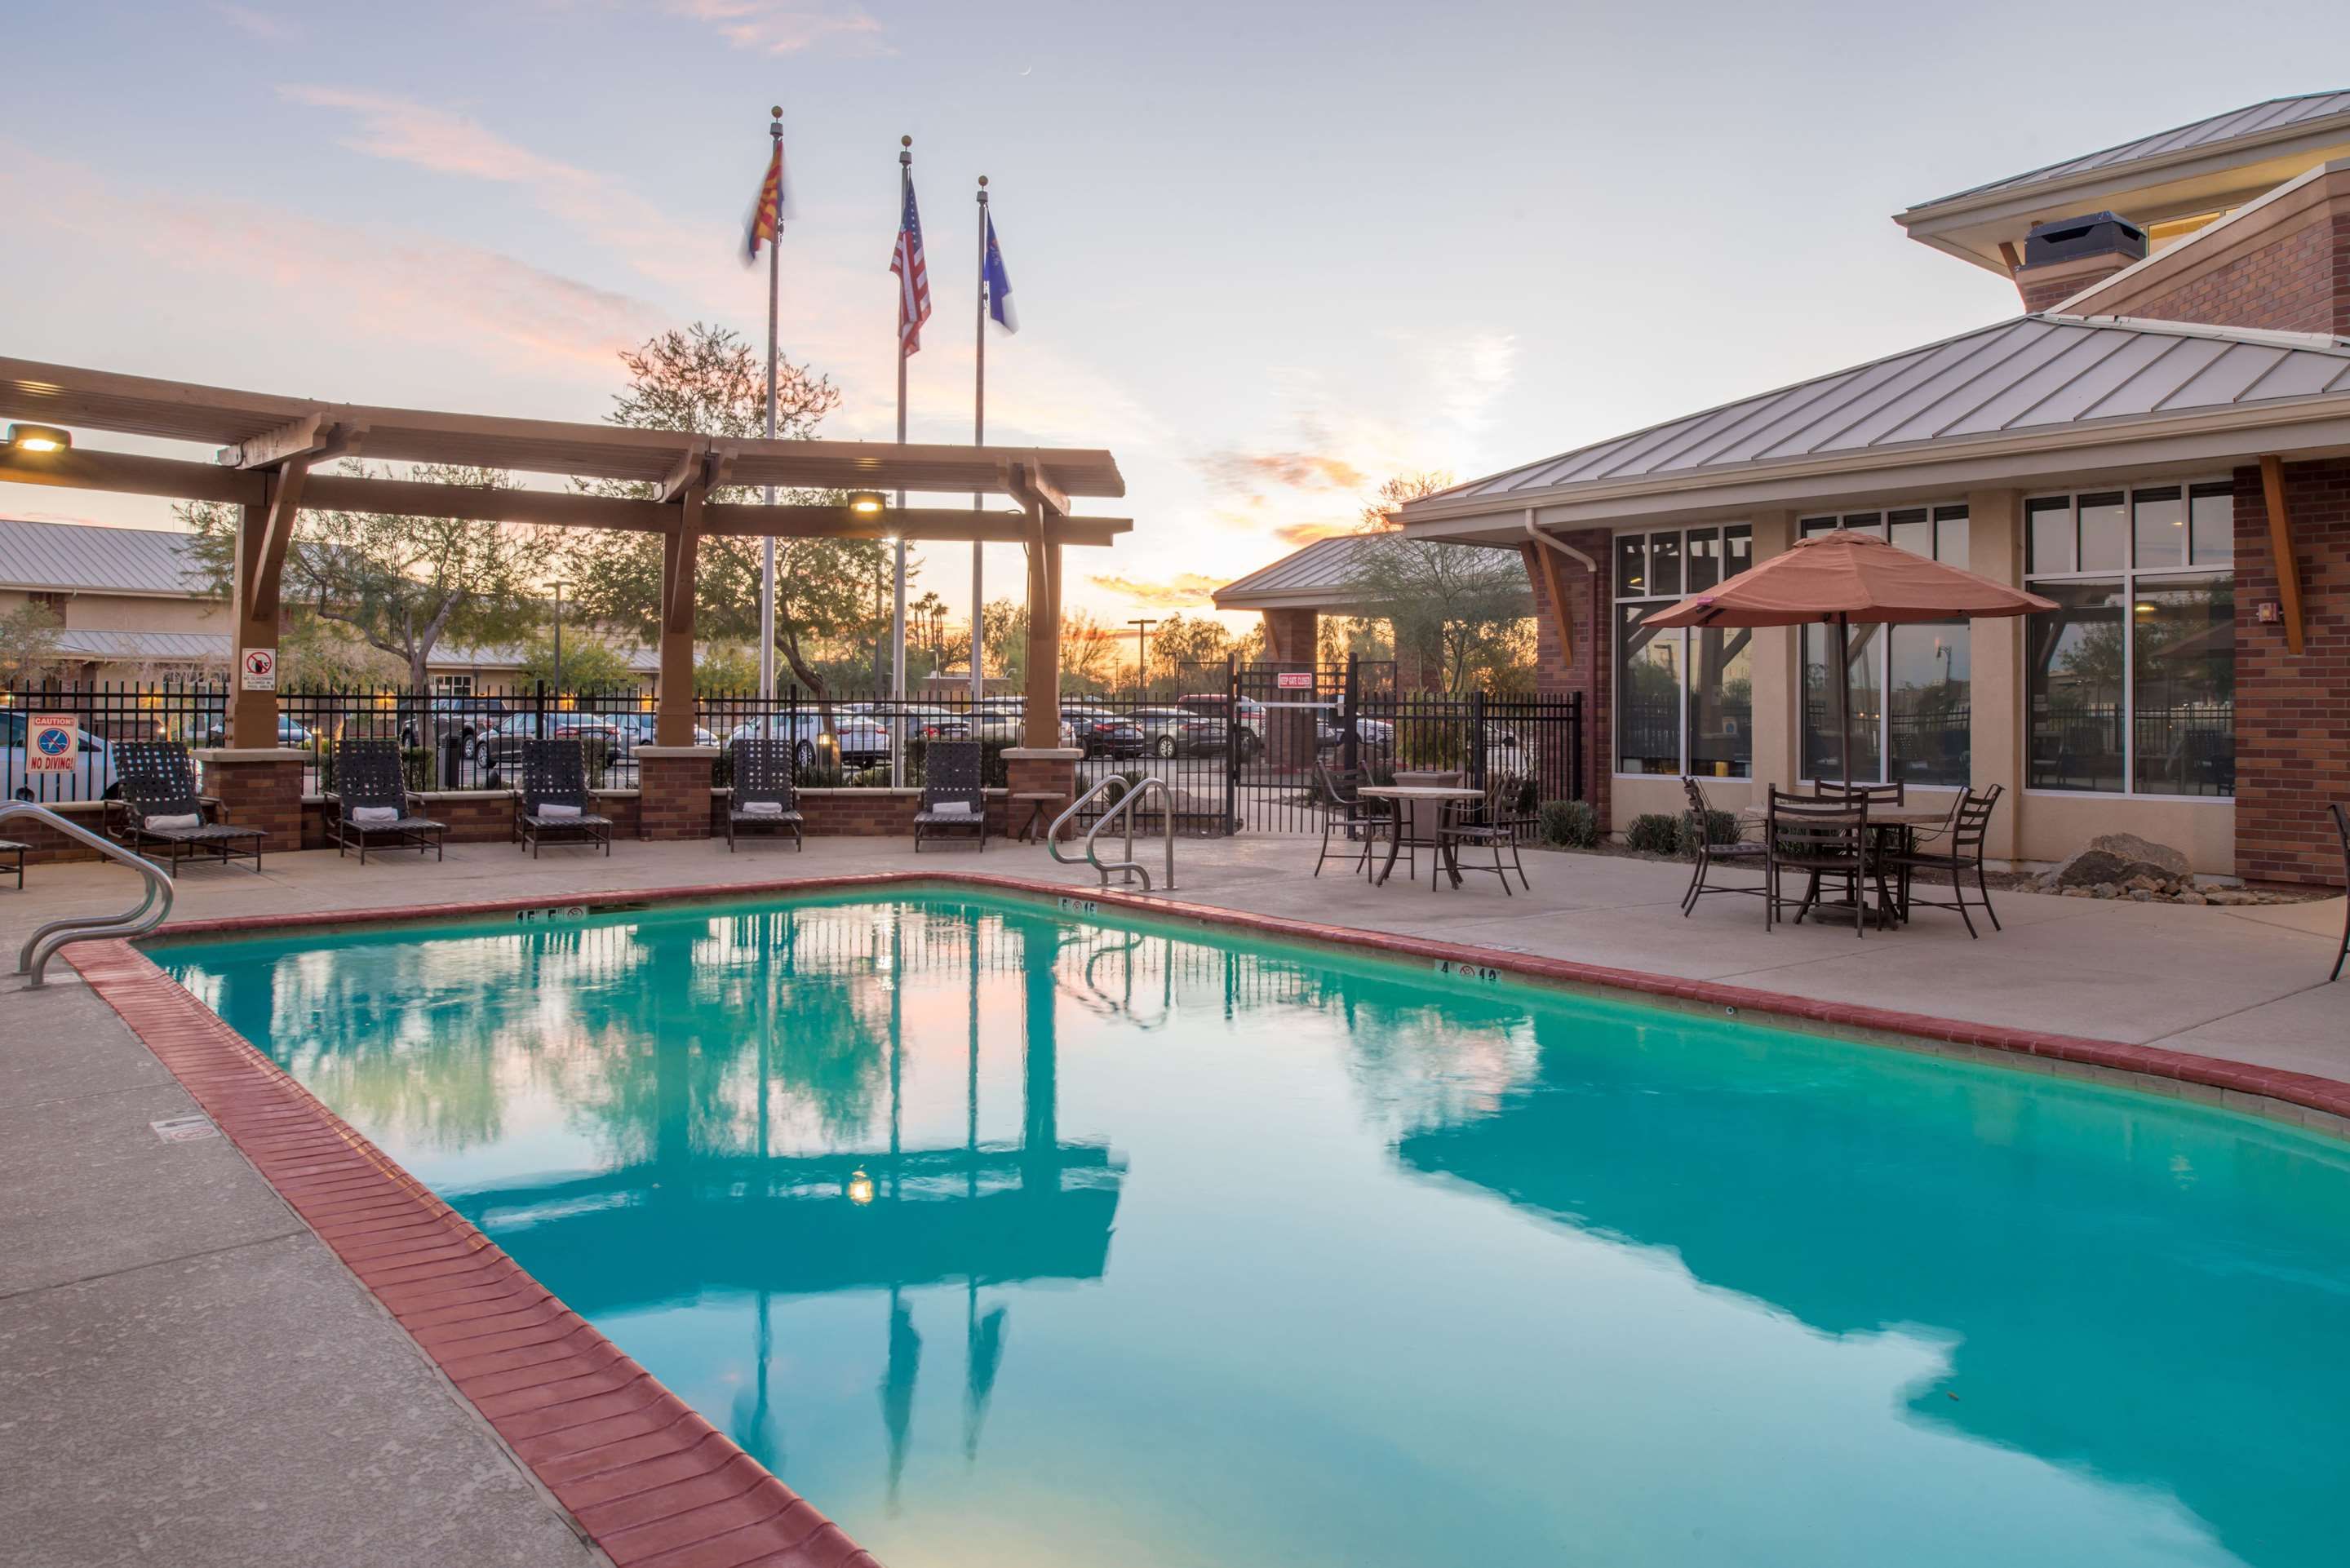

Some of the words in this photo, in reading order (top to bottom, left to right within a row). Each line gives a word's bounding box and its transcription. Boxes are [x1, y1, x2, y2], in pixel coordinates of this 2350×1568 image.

[35, 717, 73, 725] CAUTION!
[31, 757, 42, 770] NO
[45, 757, 73, 770] DIVING!
